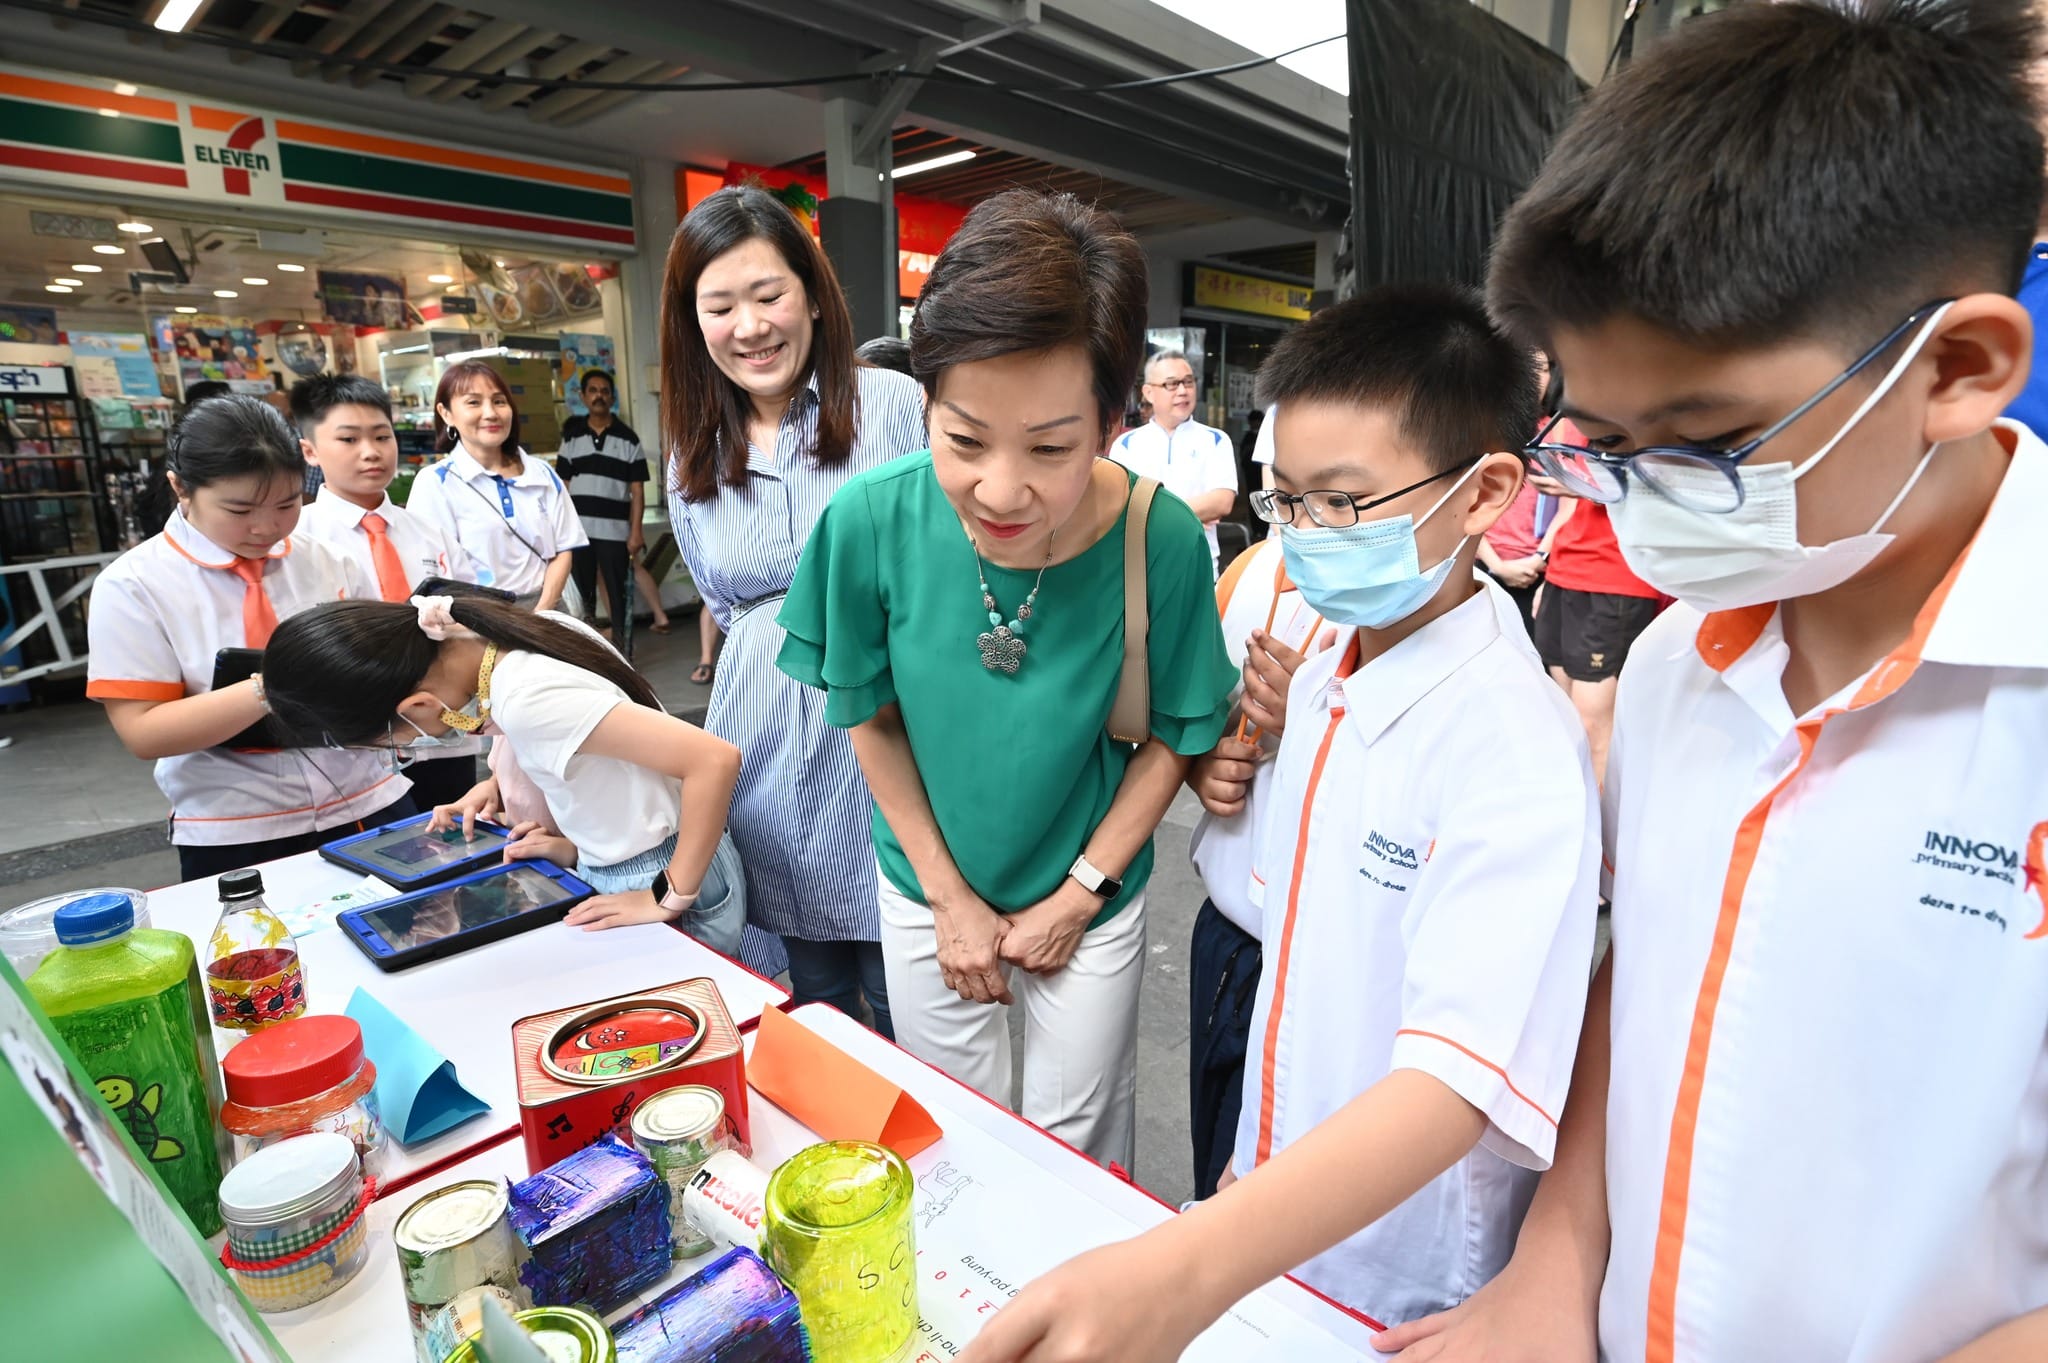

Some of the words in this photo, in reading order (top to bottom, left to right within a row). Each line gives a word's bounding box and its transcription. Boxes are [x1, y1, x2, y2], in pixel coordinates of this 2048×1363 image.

[1368, 829, 1417, 862] INNOVA
[1389, 857, 1418, 870] school
[1916, 853, 1981, 875] primary
[690, 1168, 762, 1230] nutella
[959, 1288, 971, 1299] 1
[977, 1302, 990, 1313] 2
